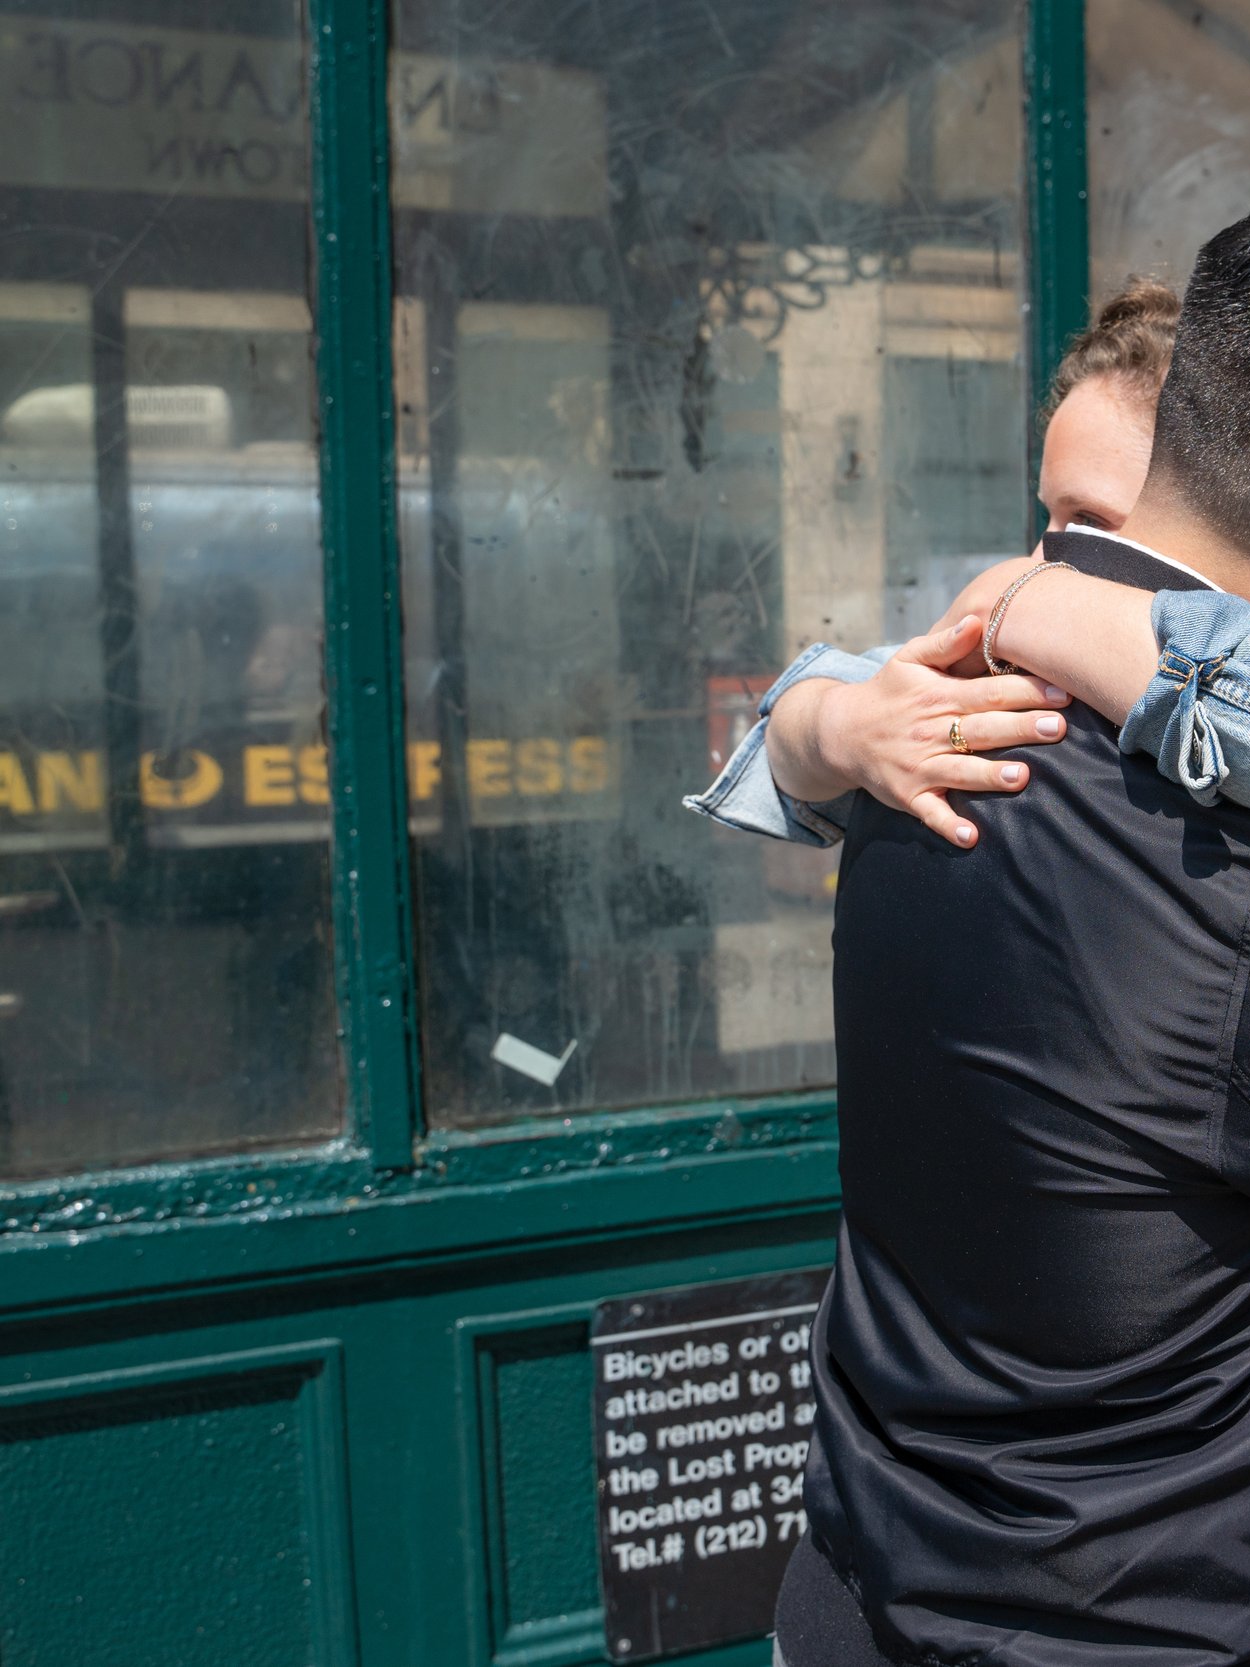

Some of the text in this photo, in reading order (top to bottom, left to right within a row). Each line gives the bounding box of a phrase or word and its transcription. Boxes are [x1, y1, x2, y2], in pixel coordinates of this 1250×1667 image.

[243, 736, 608, 805] ESESS
[603, 1340, 729, 1383] Bicycles
[738, 1333, 771, 1361] or
[605, 1372, 739, 1420] attached
[749, 1367, 780, 1397] to
[605, 1402, 817, 1458] be removed a
[608, 1441, 810, 1497] the Lost Prop
[609, 1487, 722, 1536] located
[731, 1481, 762, 1512] at
[612, 1533, 685, 1573] Tel.#
[695, 1514, 768, 1560] (212)
